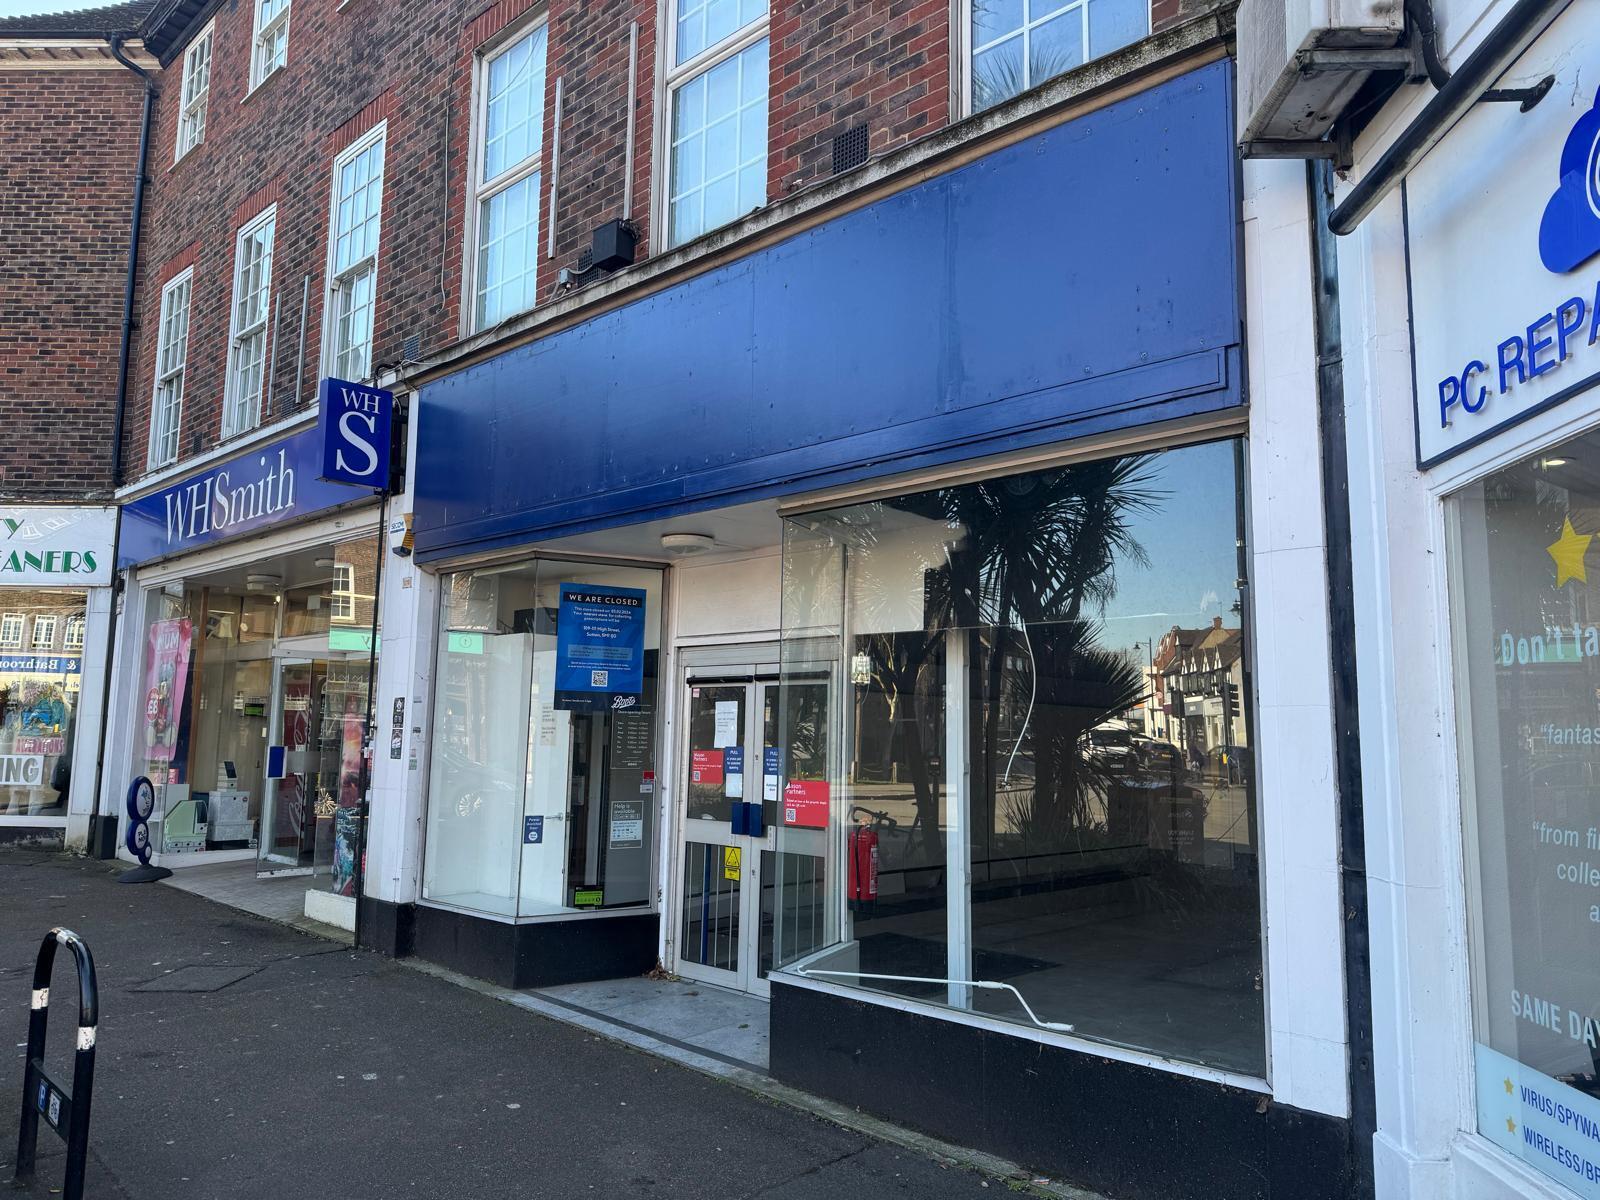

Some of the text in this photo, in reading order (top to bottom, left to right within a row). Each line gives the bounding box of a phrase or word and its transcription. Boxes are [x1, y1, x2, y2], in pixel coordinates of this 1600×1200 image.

[341, 388, 380, 415] WH
[1439, 360, 1487, 428] PC
[336, 411, 378, 476] S
[165, 449, 295, 545] WHSmith
[0, 549, 97, 574] ANERS
[569, 594, 638, 606] WE ARE CLOSED
[1501, 625, 1565, 667] Don't
[611, 695, 636, 709] Boots
[0, 757, 40, 783] ING
[1511, 989, 1562, 1035] SAME
